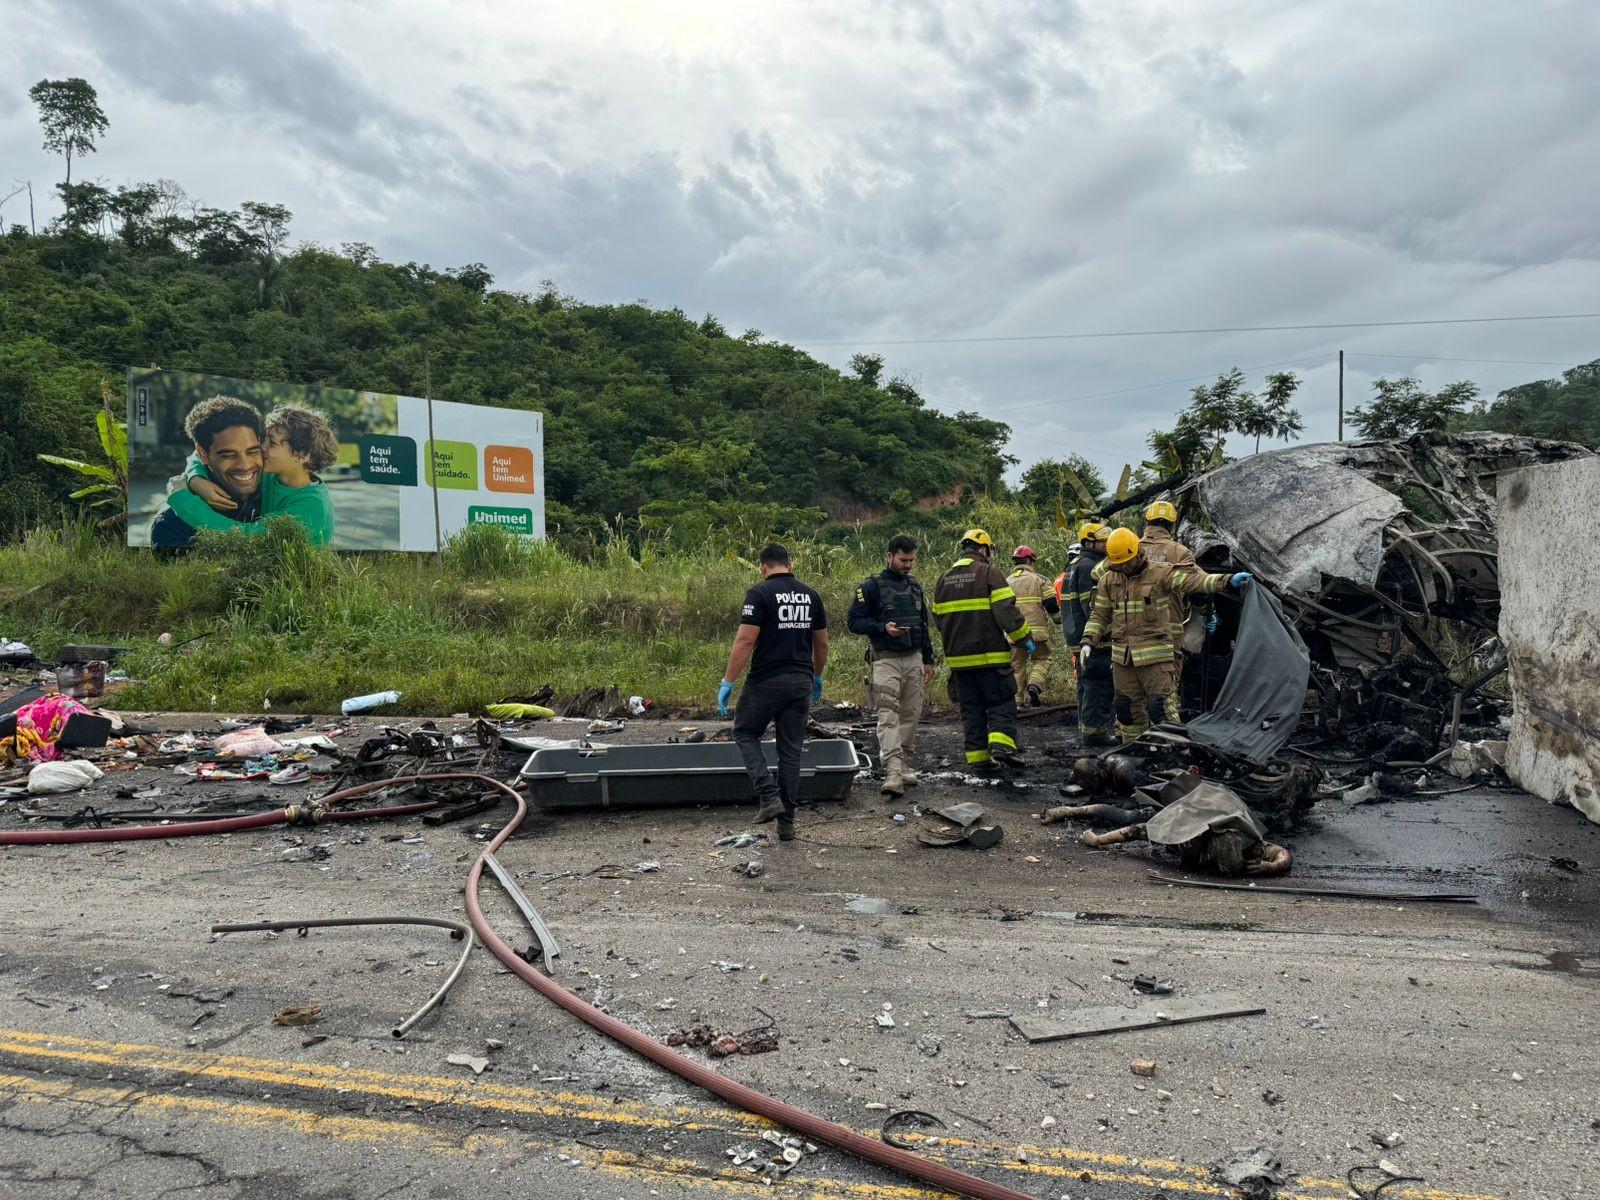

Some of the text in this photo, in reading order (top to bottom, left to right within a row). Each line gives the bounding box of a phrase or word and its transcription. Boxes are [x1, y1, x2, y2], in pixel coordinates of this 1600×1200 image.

[369, 446, 391, 457] Aqui
[433, 451, 454, 462] Aqui
[370, 455, 388, 464] tem
[492, 456, 511, 467] Aqui
[370, 464, 401, 474] saúde.
[492, 466, 509, 474] tem
[492, 473, 527, 484] Unimed.
[474, 511, 527, 525] Unimed
[775, 591, 811, 604] POLÍCIA
[778, 605, 811, 622] CIVIL
